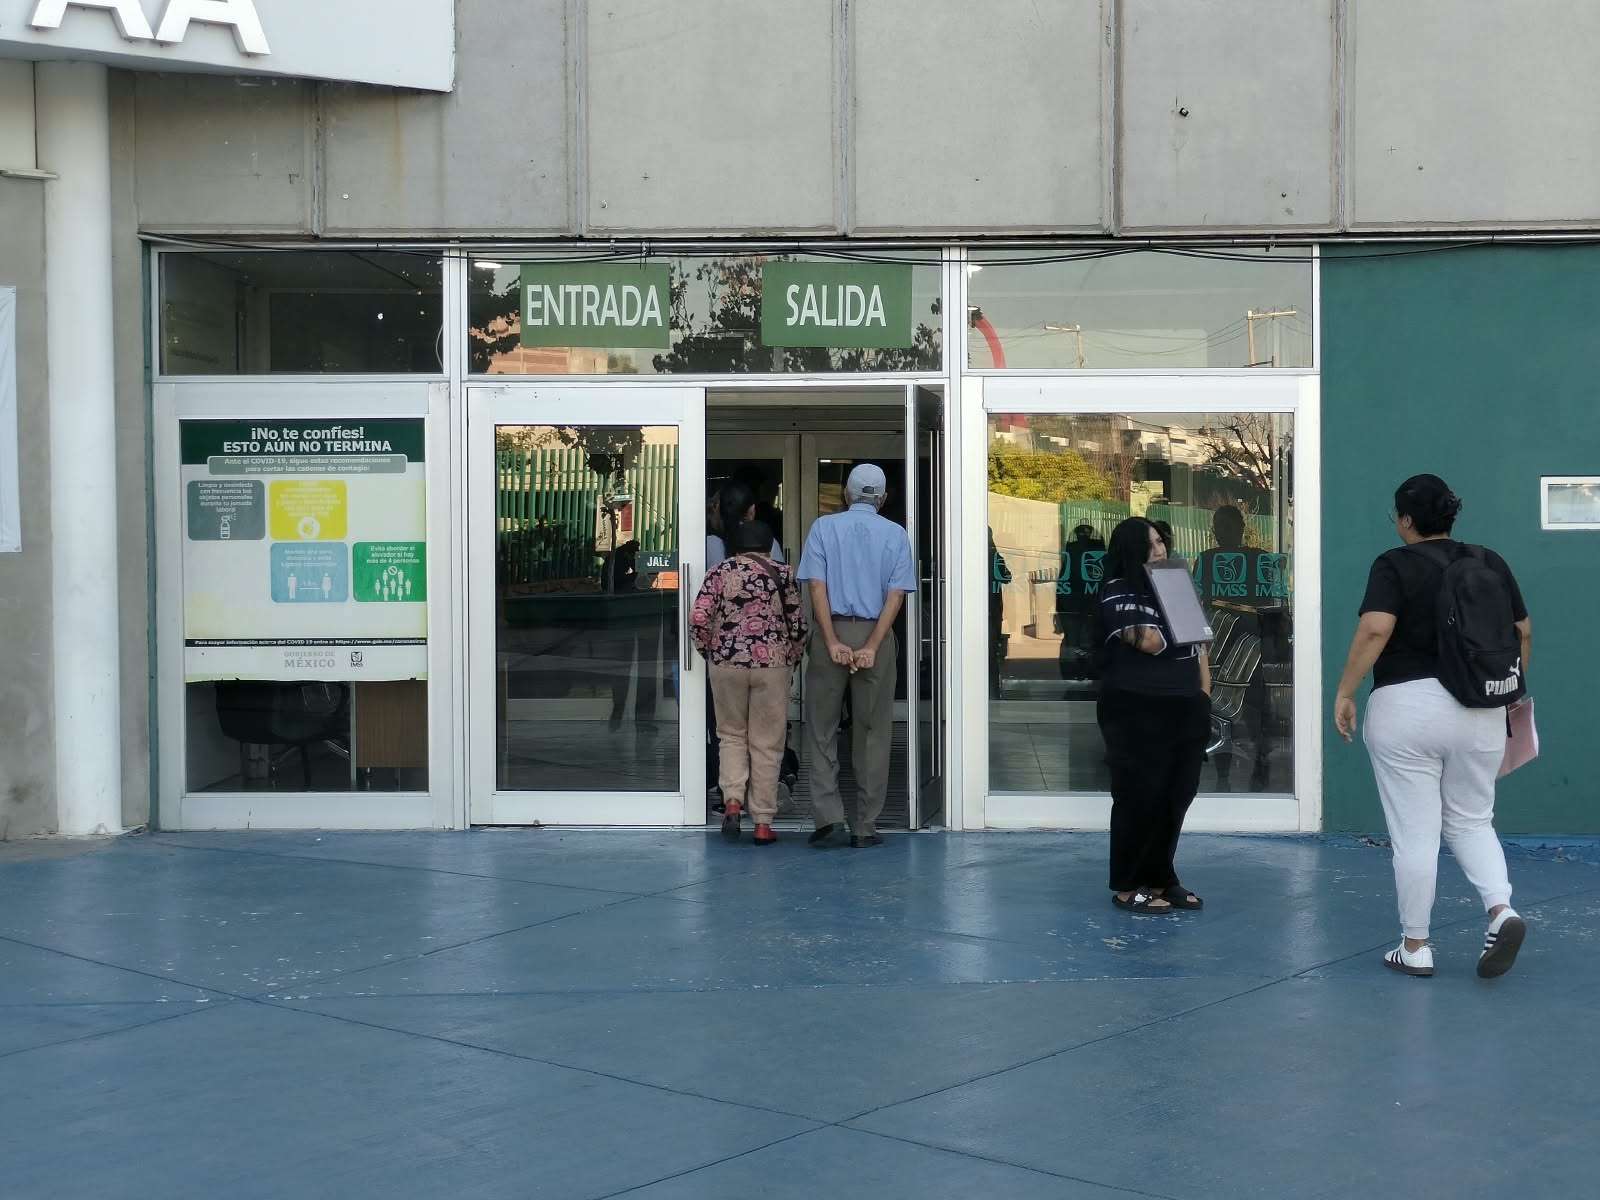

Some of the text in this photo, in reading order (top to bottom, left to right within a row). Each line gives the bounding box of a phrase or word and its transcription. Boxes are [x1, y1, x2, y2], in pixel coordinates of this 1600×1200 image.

[526, 283, 663, 328] ENTRADA
[786, 283, 888, 328] SALIDA
[282, 428, 299, 440] te
[303, 425, 365, 440] confíes!
[223, 437, 392, 453] ESTO AÚN NO TERMINA
[1211, 584, 1248, 597] IMSS
[284, 656, 336, 668] MÉXICO
[1485, 674, 1518, 696] PUMA
